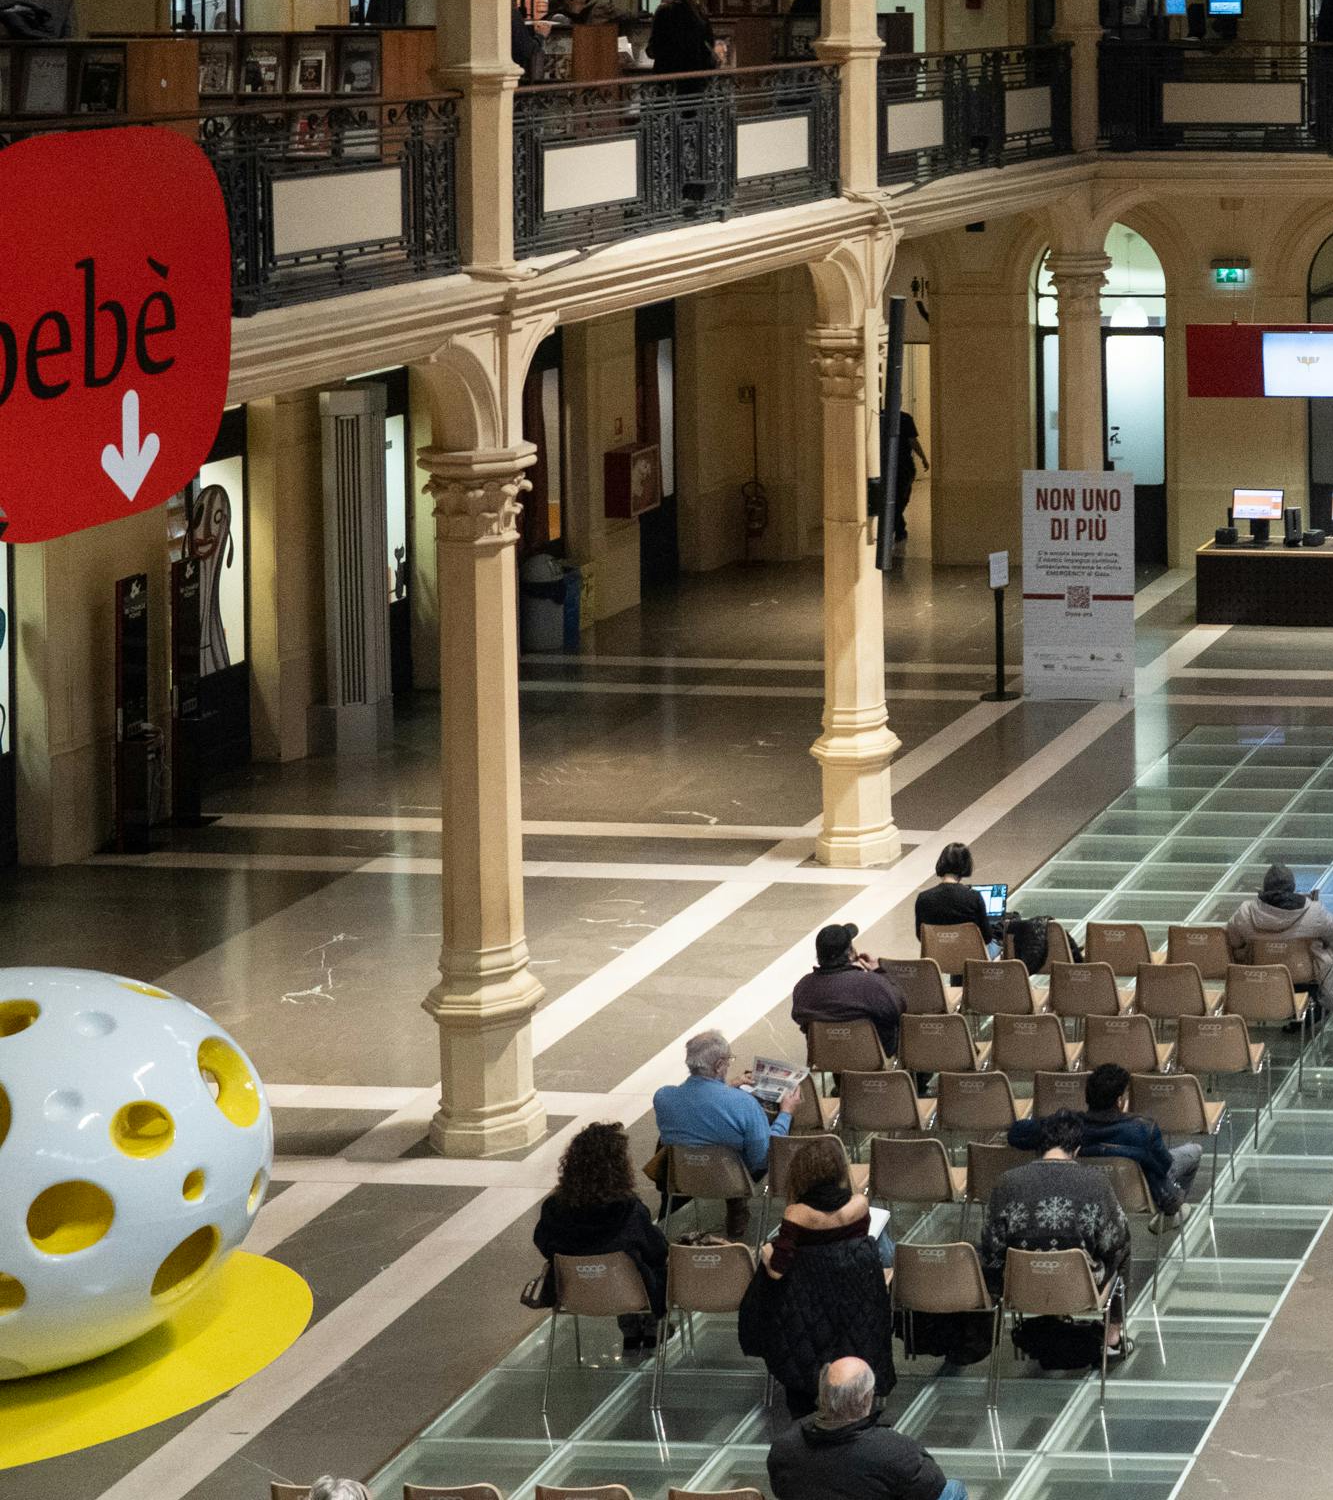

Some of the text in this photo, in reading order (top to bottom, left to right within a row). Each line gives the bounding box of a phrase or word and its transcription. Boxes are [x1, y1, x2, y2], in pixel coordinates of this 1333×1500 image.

[1036, 488, 1121, 512] NON UNO
[1050, 514, 1107, 541] DI PIÙ
